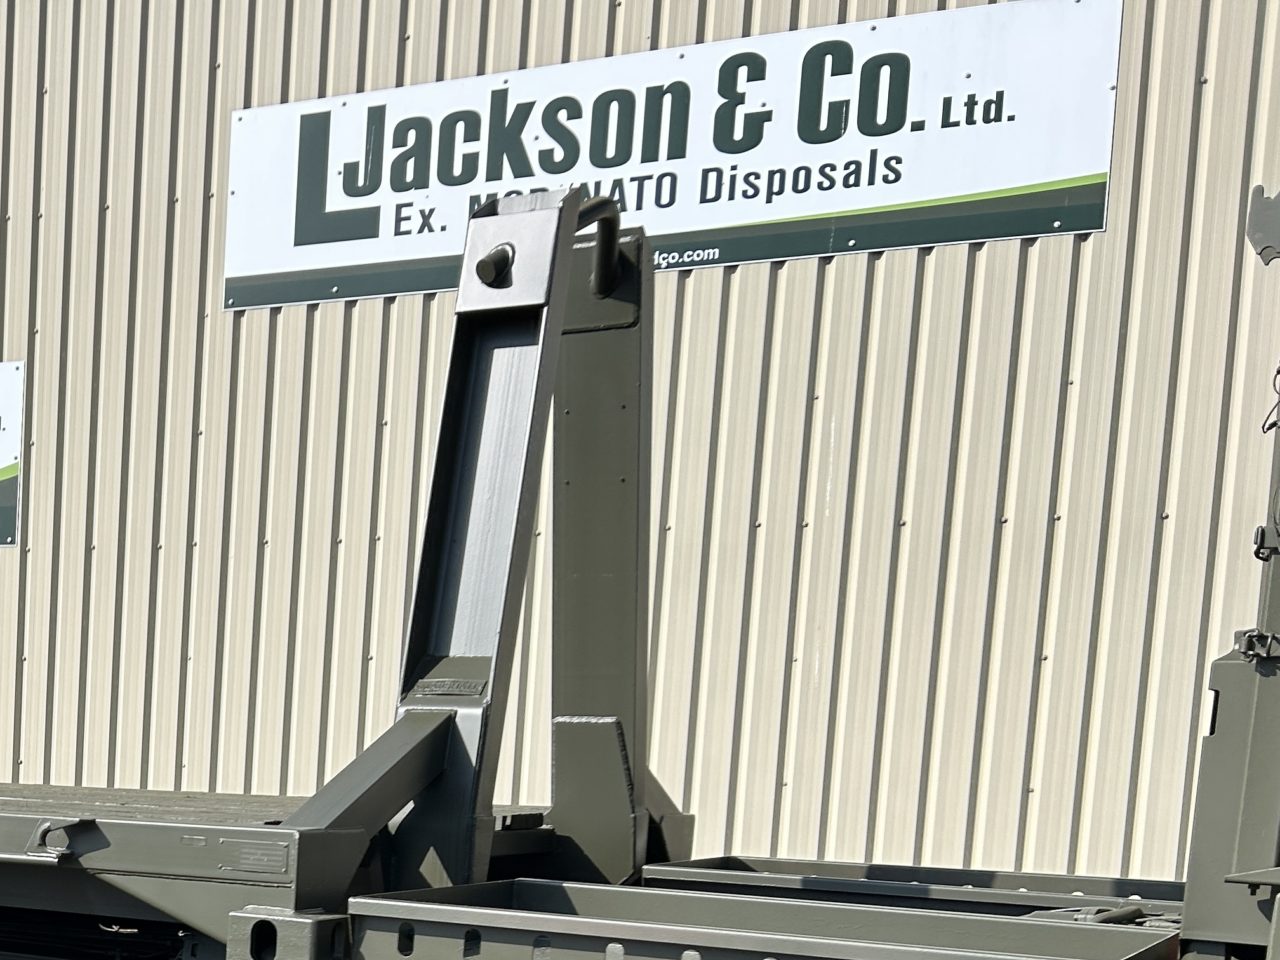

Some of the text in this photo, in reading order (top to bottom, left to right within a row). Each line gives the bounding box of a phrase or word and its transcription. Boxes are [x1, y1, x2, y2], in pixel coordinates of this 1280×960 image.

[712, 51, 774, 155] &
[797, 39, 927, 146] Co.
[940, 90, 1017, 129] Ltd.
[393, 148, 904, 238] Ex. NATO Disposals
